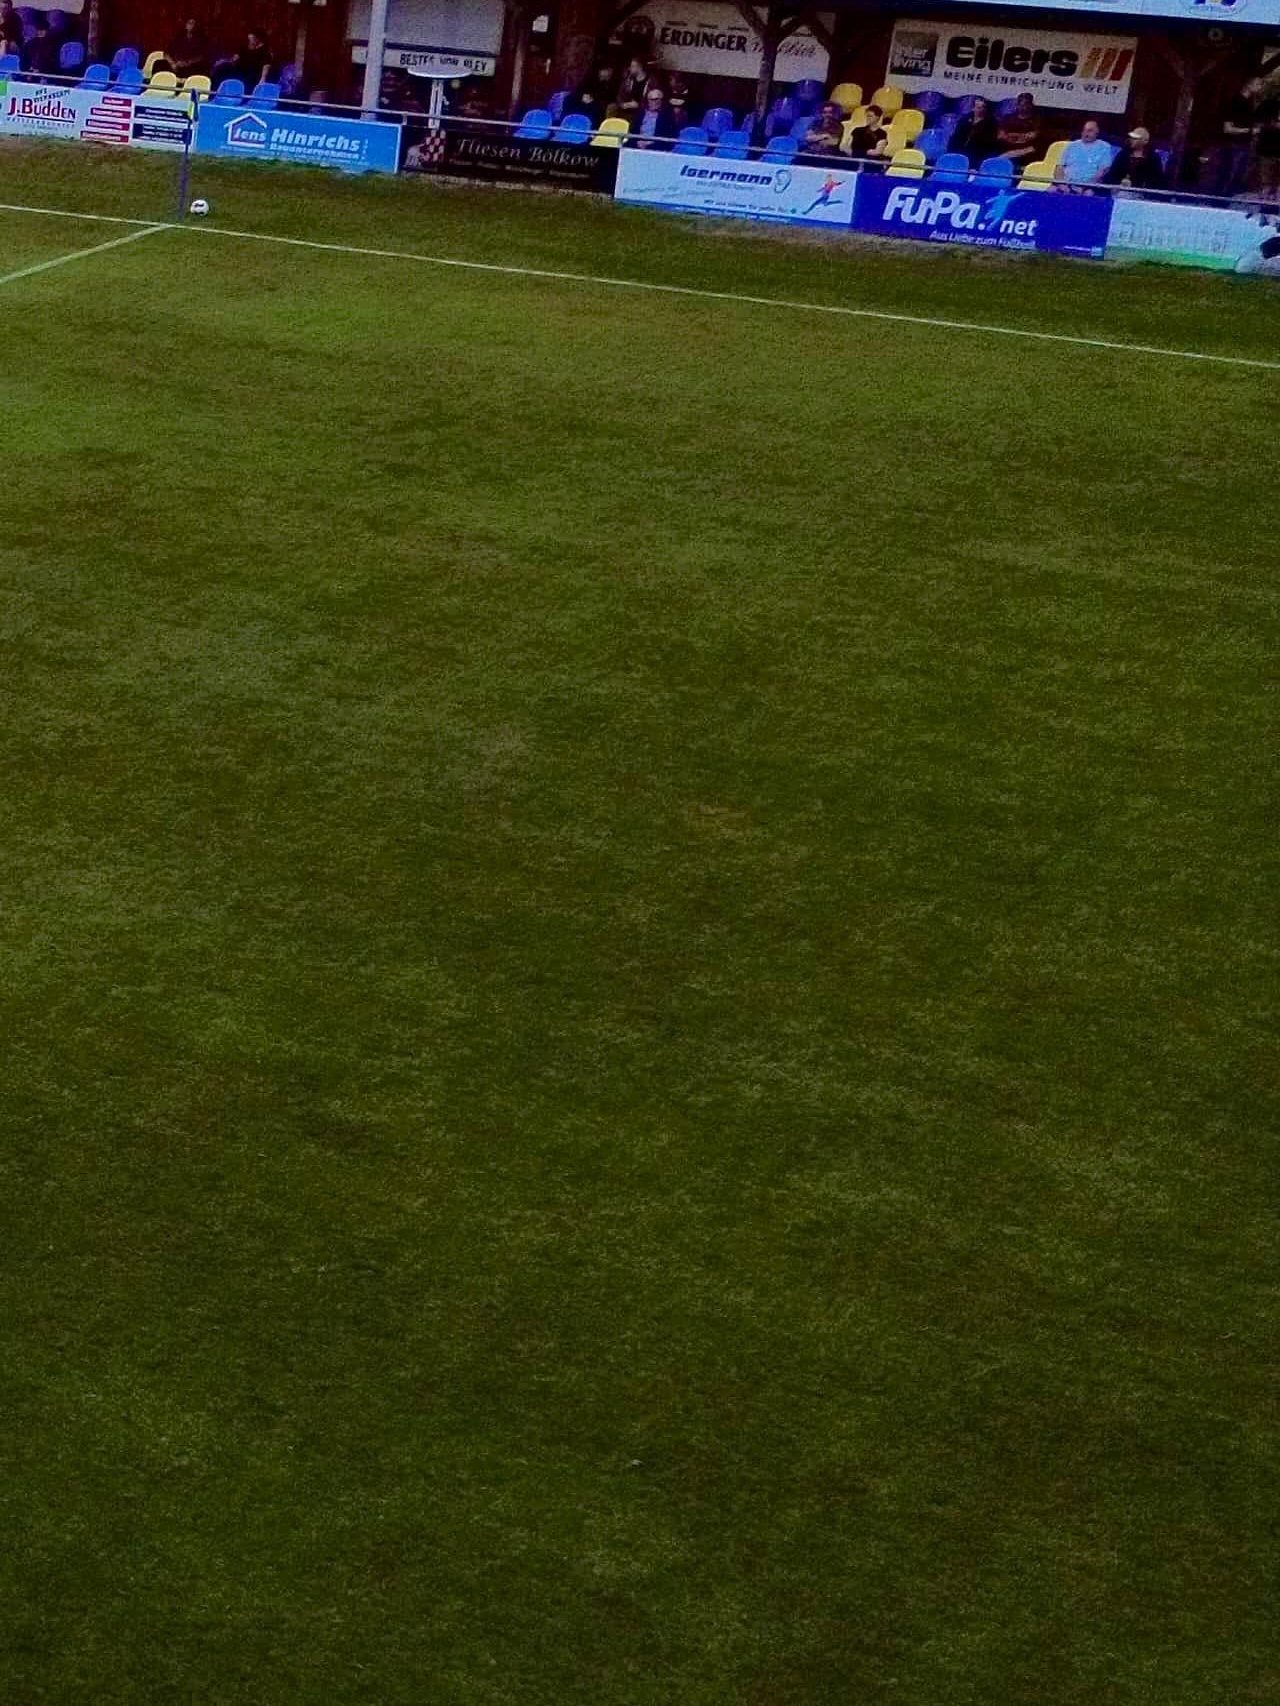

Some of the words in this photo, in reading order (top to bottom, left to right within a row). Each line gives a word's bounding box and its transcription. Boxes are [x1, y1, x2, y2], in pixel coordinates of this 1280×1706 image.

[660, 27, 748, 53] ERDINGER
[946, 36, 1079, 77] Eilers
[943, 70, 983, 84] MEINE
[987, 74, 1075, 91] EINRICHTUNG
[1083, 84, 1119, 95] WELT
[234, 128, 266, 142] Jens
[271, 128, 361, 152] Hinrichs
[528, 146, 600, 167] Bölkow
[929, 229, 948, 241] Aus
[948, 231, 975, 244] Liebe
[975, 236, 997, 247] zum
